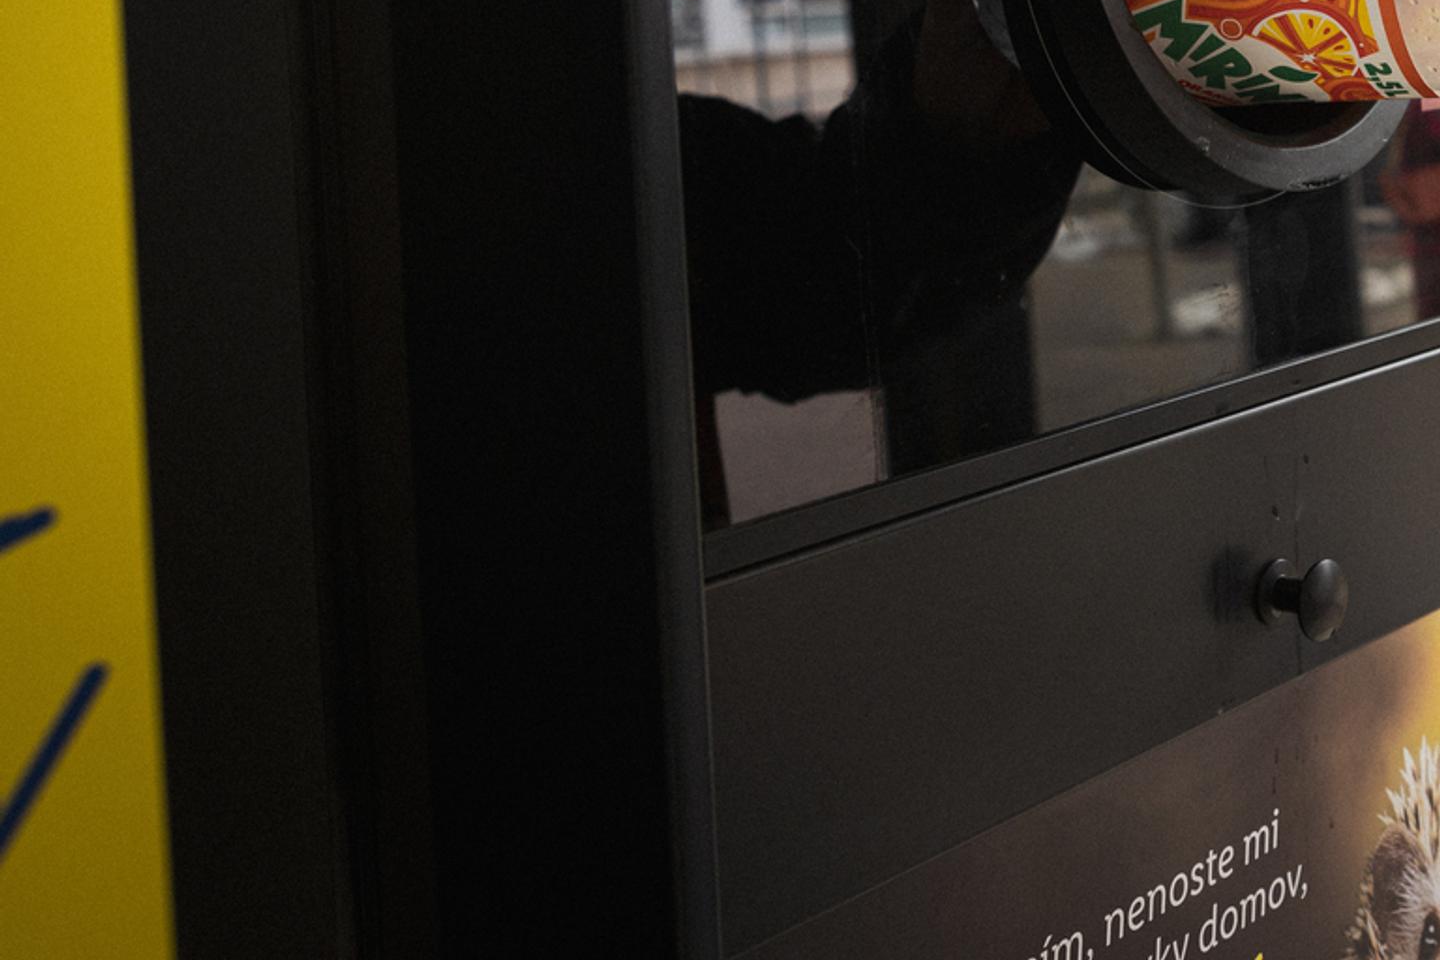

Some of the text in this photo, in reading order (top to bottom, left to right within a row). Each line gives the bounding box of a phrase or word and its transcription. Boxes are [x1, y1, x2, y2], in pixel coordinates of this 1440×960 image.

[1104, 845, 1235, 946] nenoste
[1243, 808, 1279, 865] mi
[1199, 864, 1308, 954] domov,
